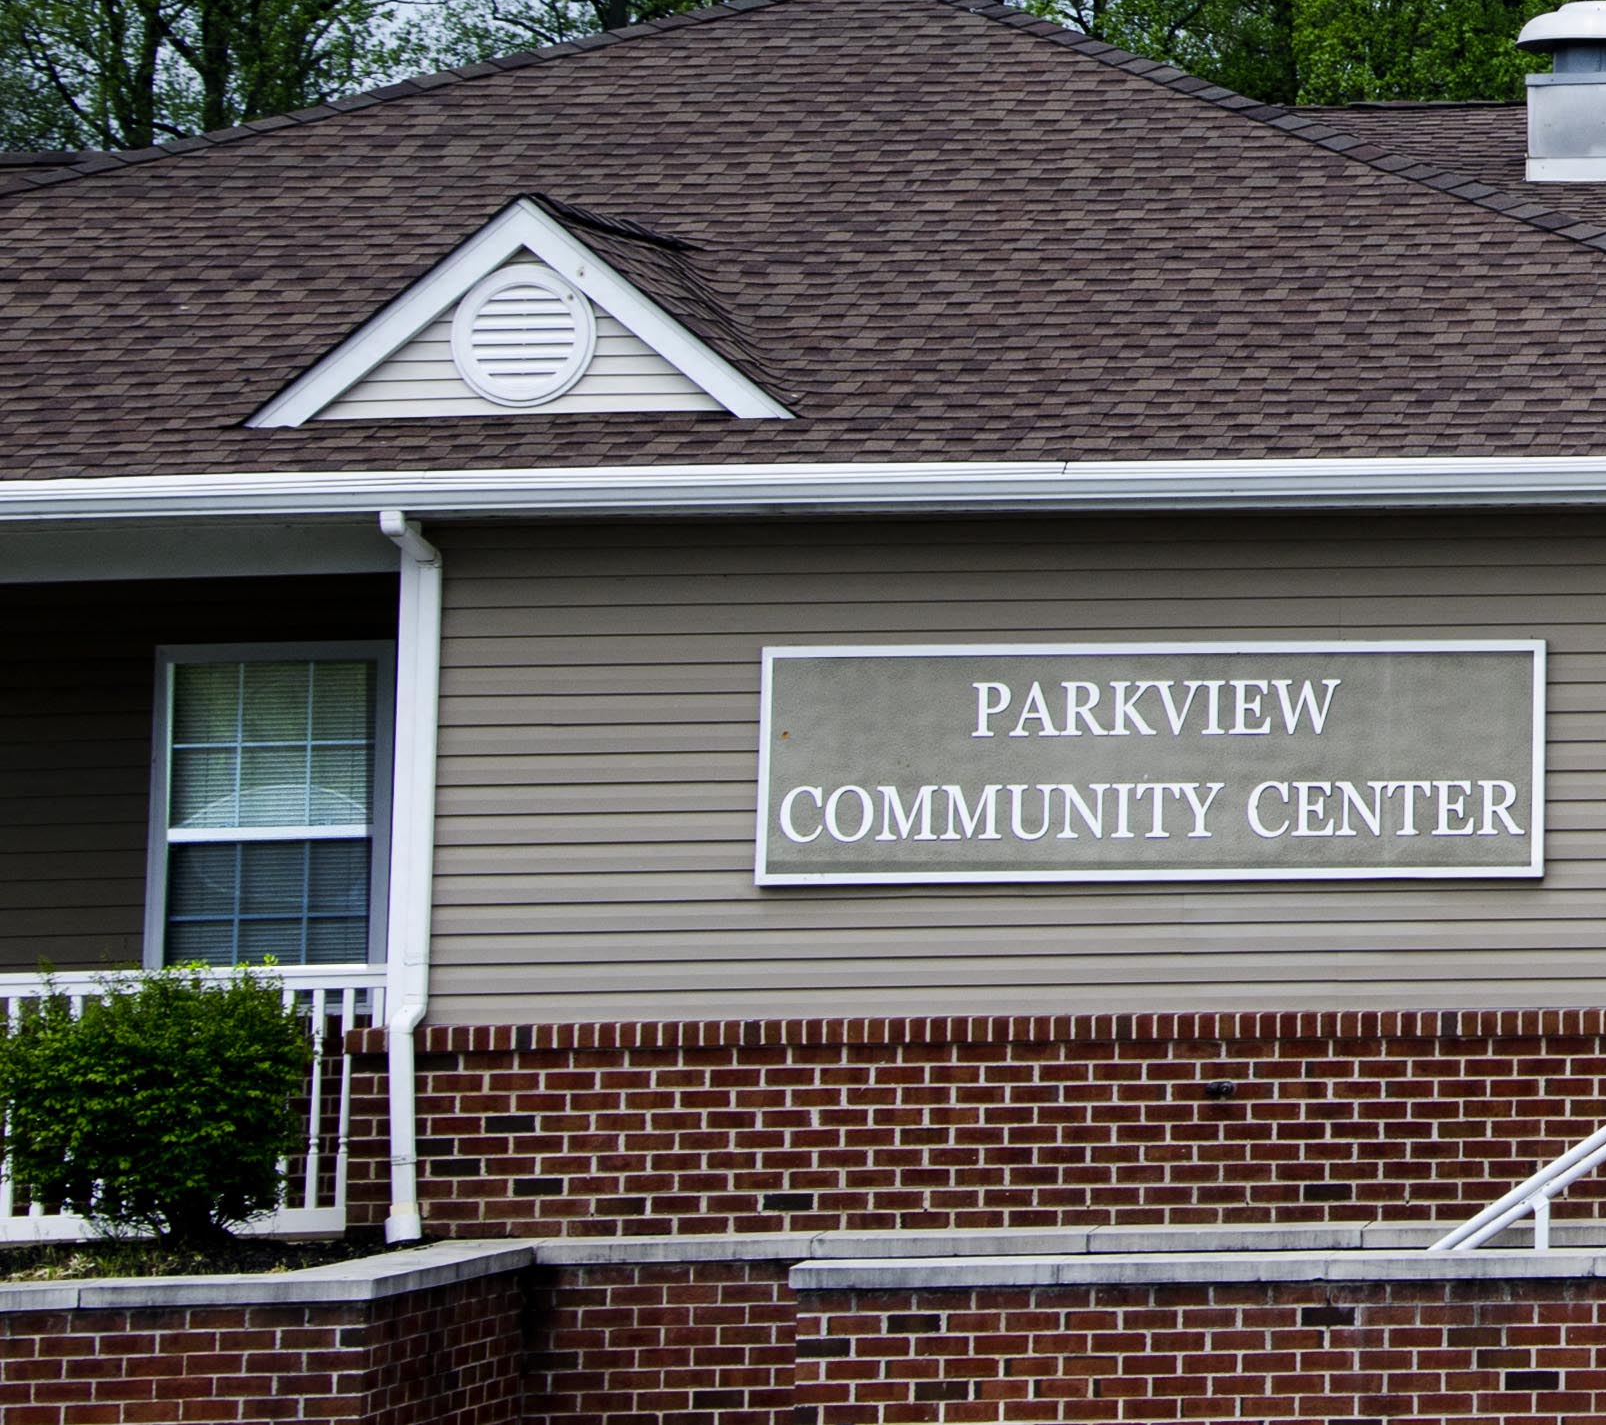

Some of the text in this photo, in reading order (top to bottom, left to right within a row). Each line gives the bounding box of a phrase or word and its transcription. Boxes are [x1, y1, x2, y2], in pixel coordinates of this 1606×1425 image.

[971, 679, 1341, 738] PARKVIEW
[779, 779, 1527, 844] COMMUNITY CENTER
